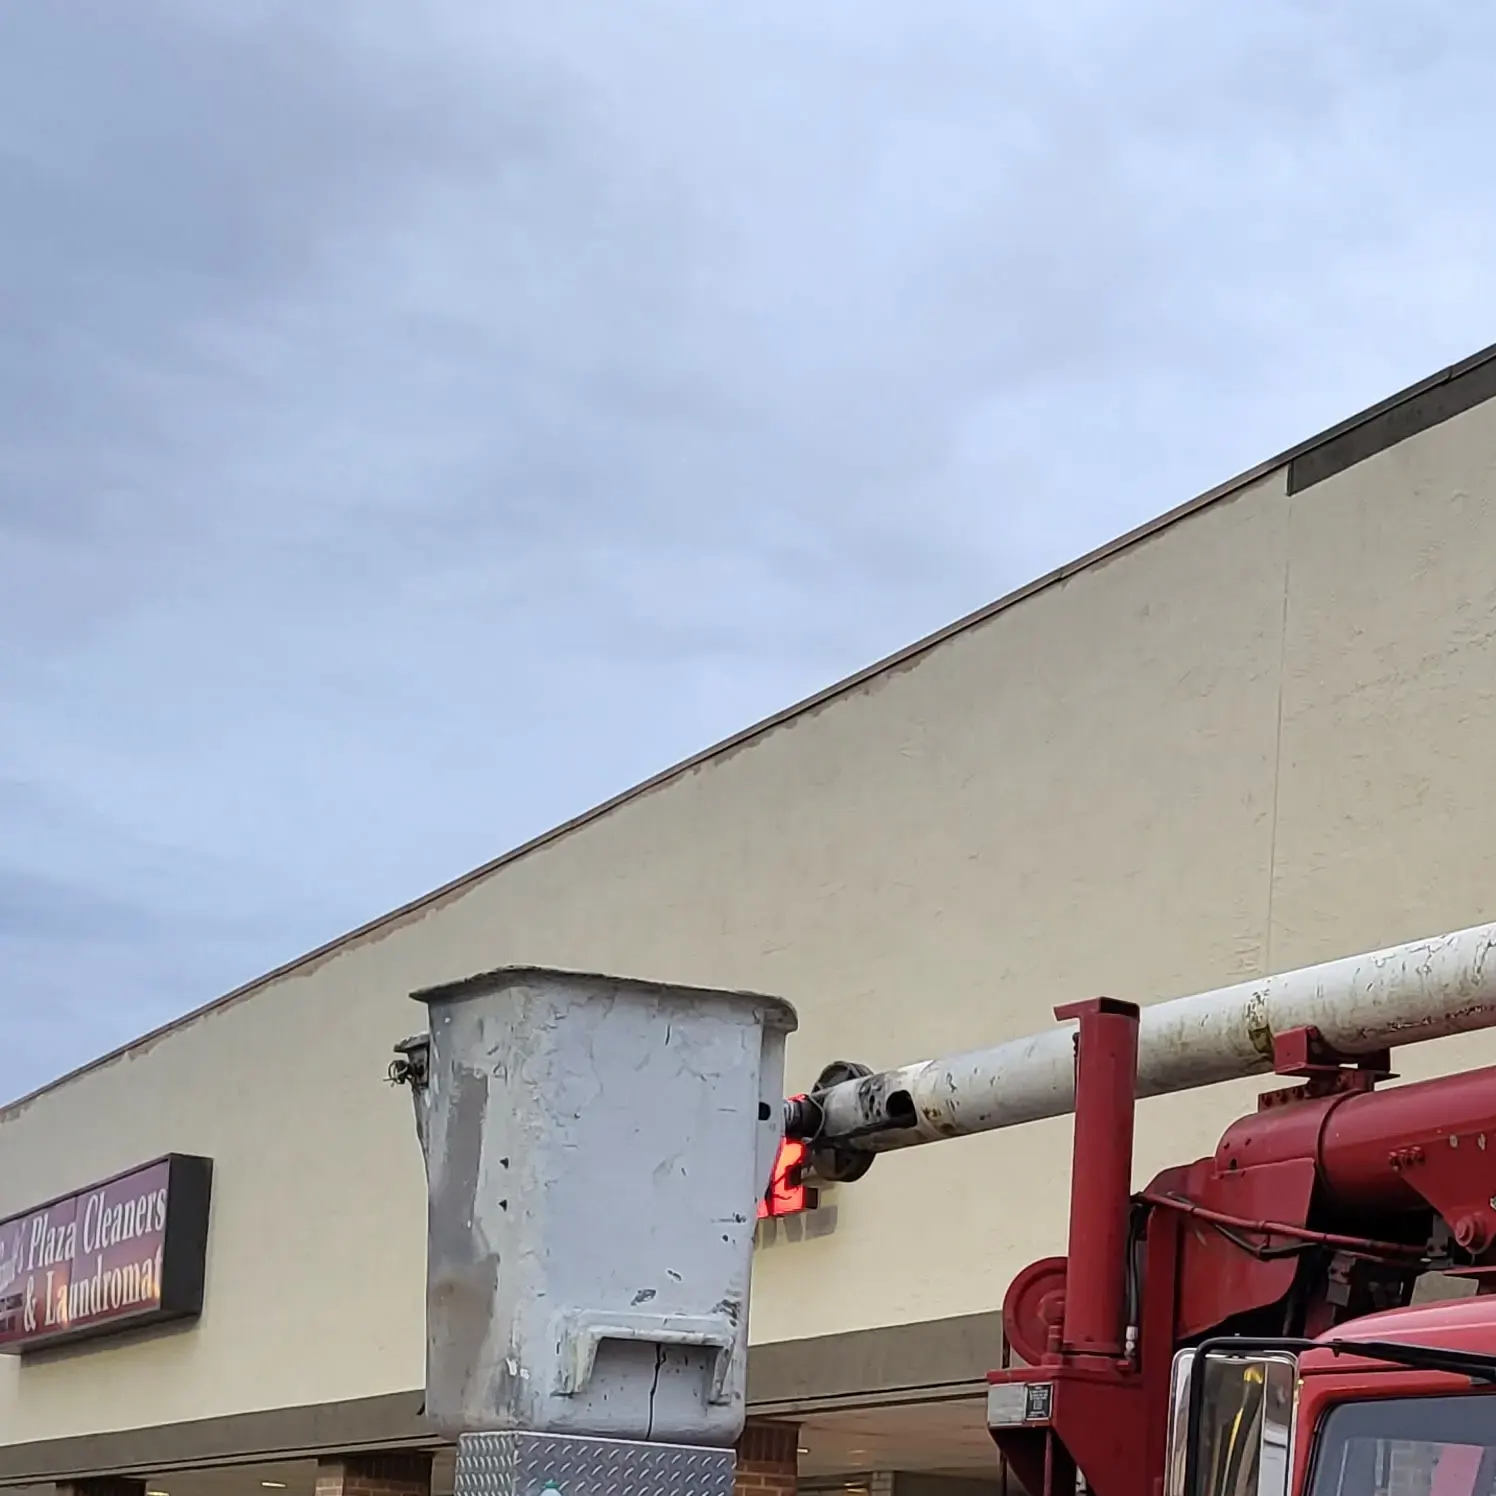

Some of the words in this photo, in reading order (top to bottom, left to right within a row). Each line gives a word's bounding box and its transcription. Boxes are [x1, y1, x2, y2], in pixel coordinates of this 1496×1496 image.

[27, 1211, 77, 1271] Plaza
[83, 1188, 167, 1254] Cleaners
[24, 1275, 36, 1332] &
[44, 1244, 163, 1326] Laundromat
